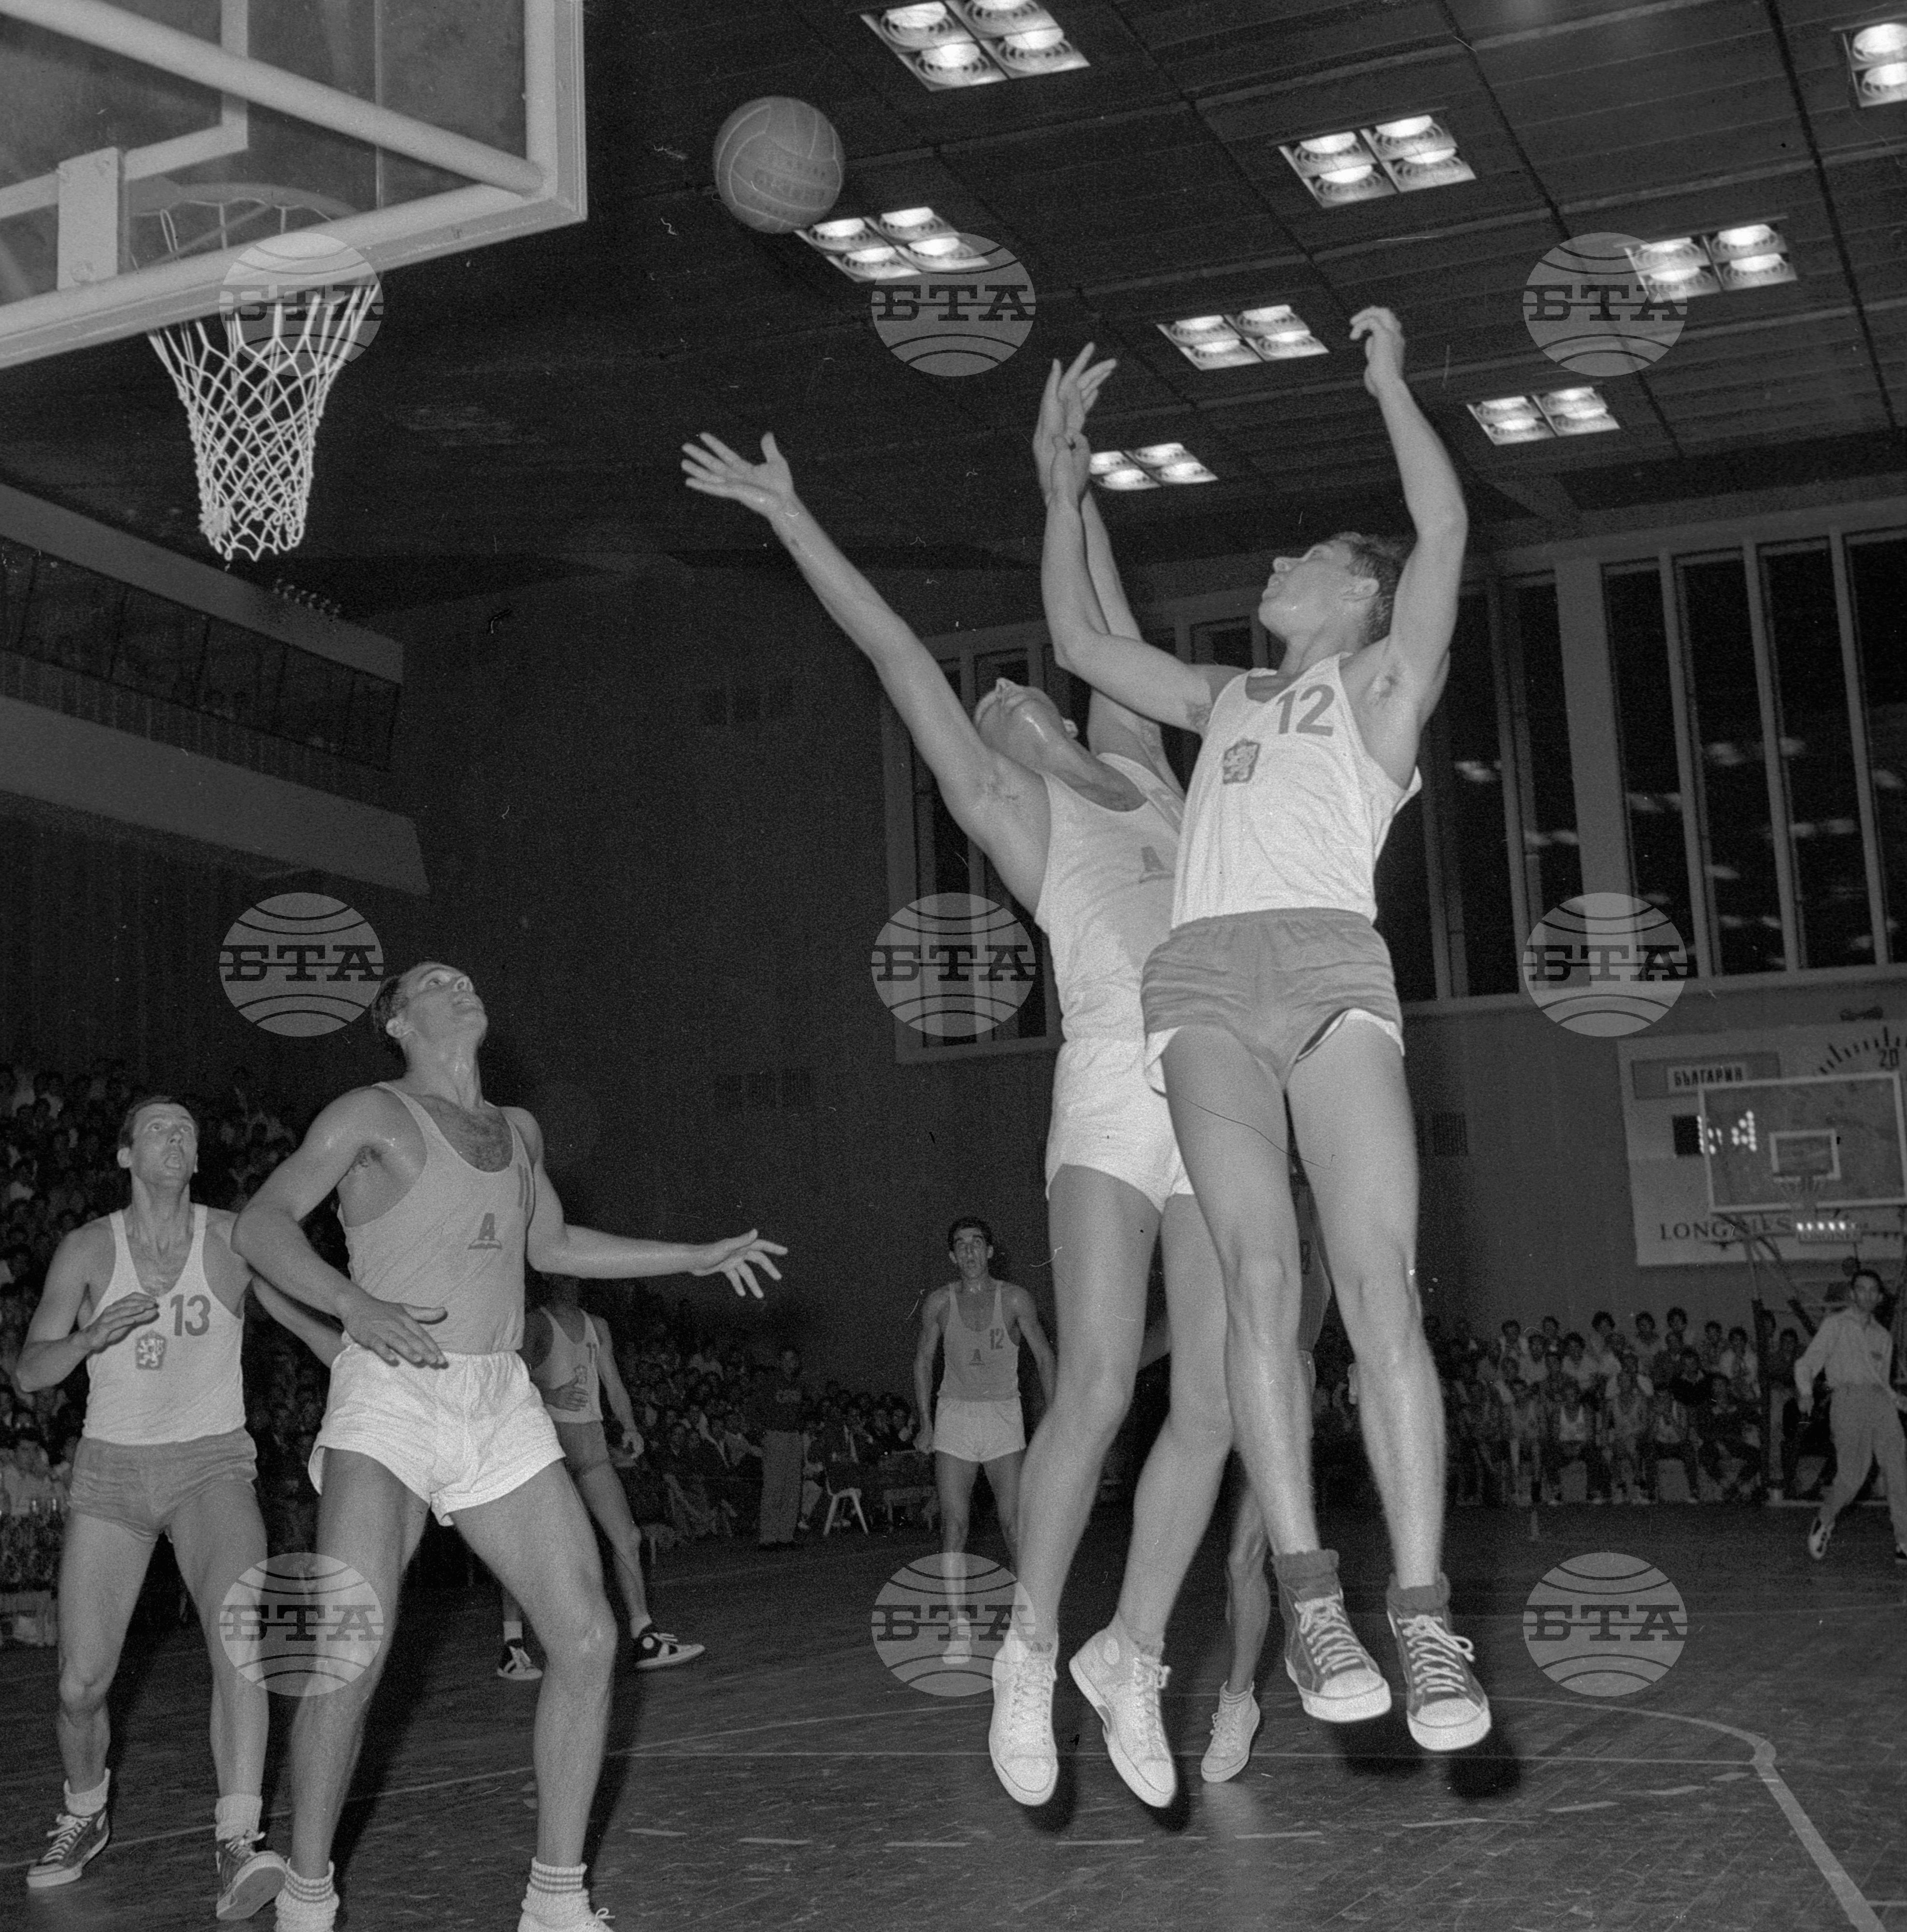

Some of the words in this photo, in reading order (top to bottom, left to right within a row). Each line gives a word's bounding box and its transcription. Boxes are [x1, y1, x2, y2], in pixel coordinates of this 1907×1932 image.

[1276, 684, 1335, 737] 12
[1879, 1048, 1899, 1067] 20
[170, 1294, 211, 1337] 13
[989, 1328, 1004, 1350] 12
